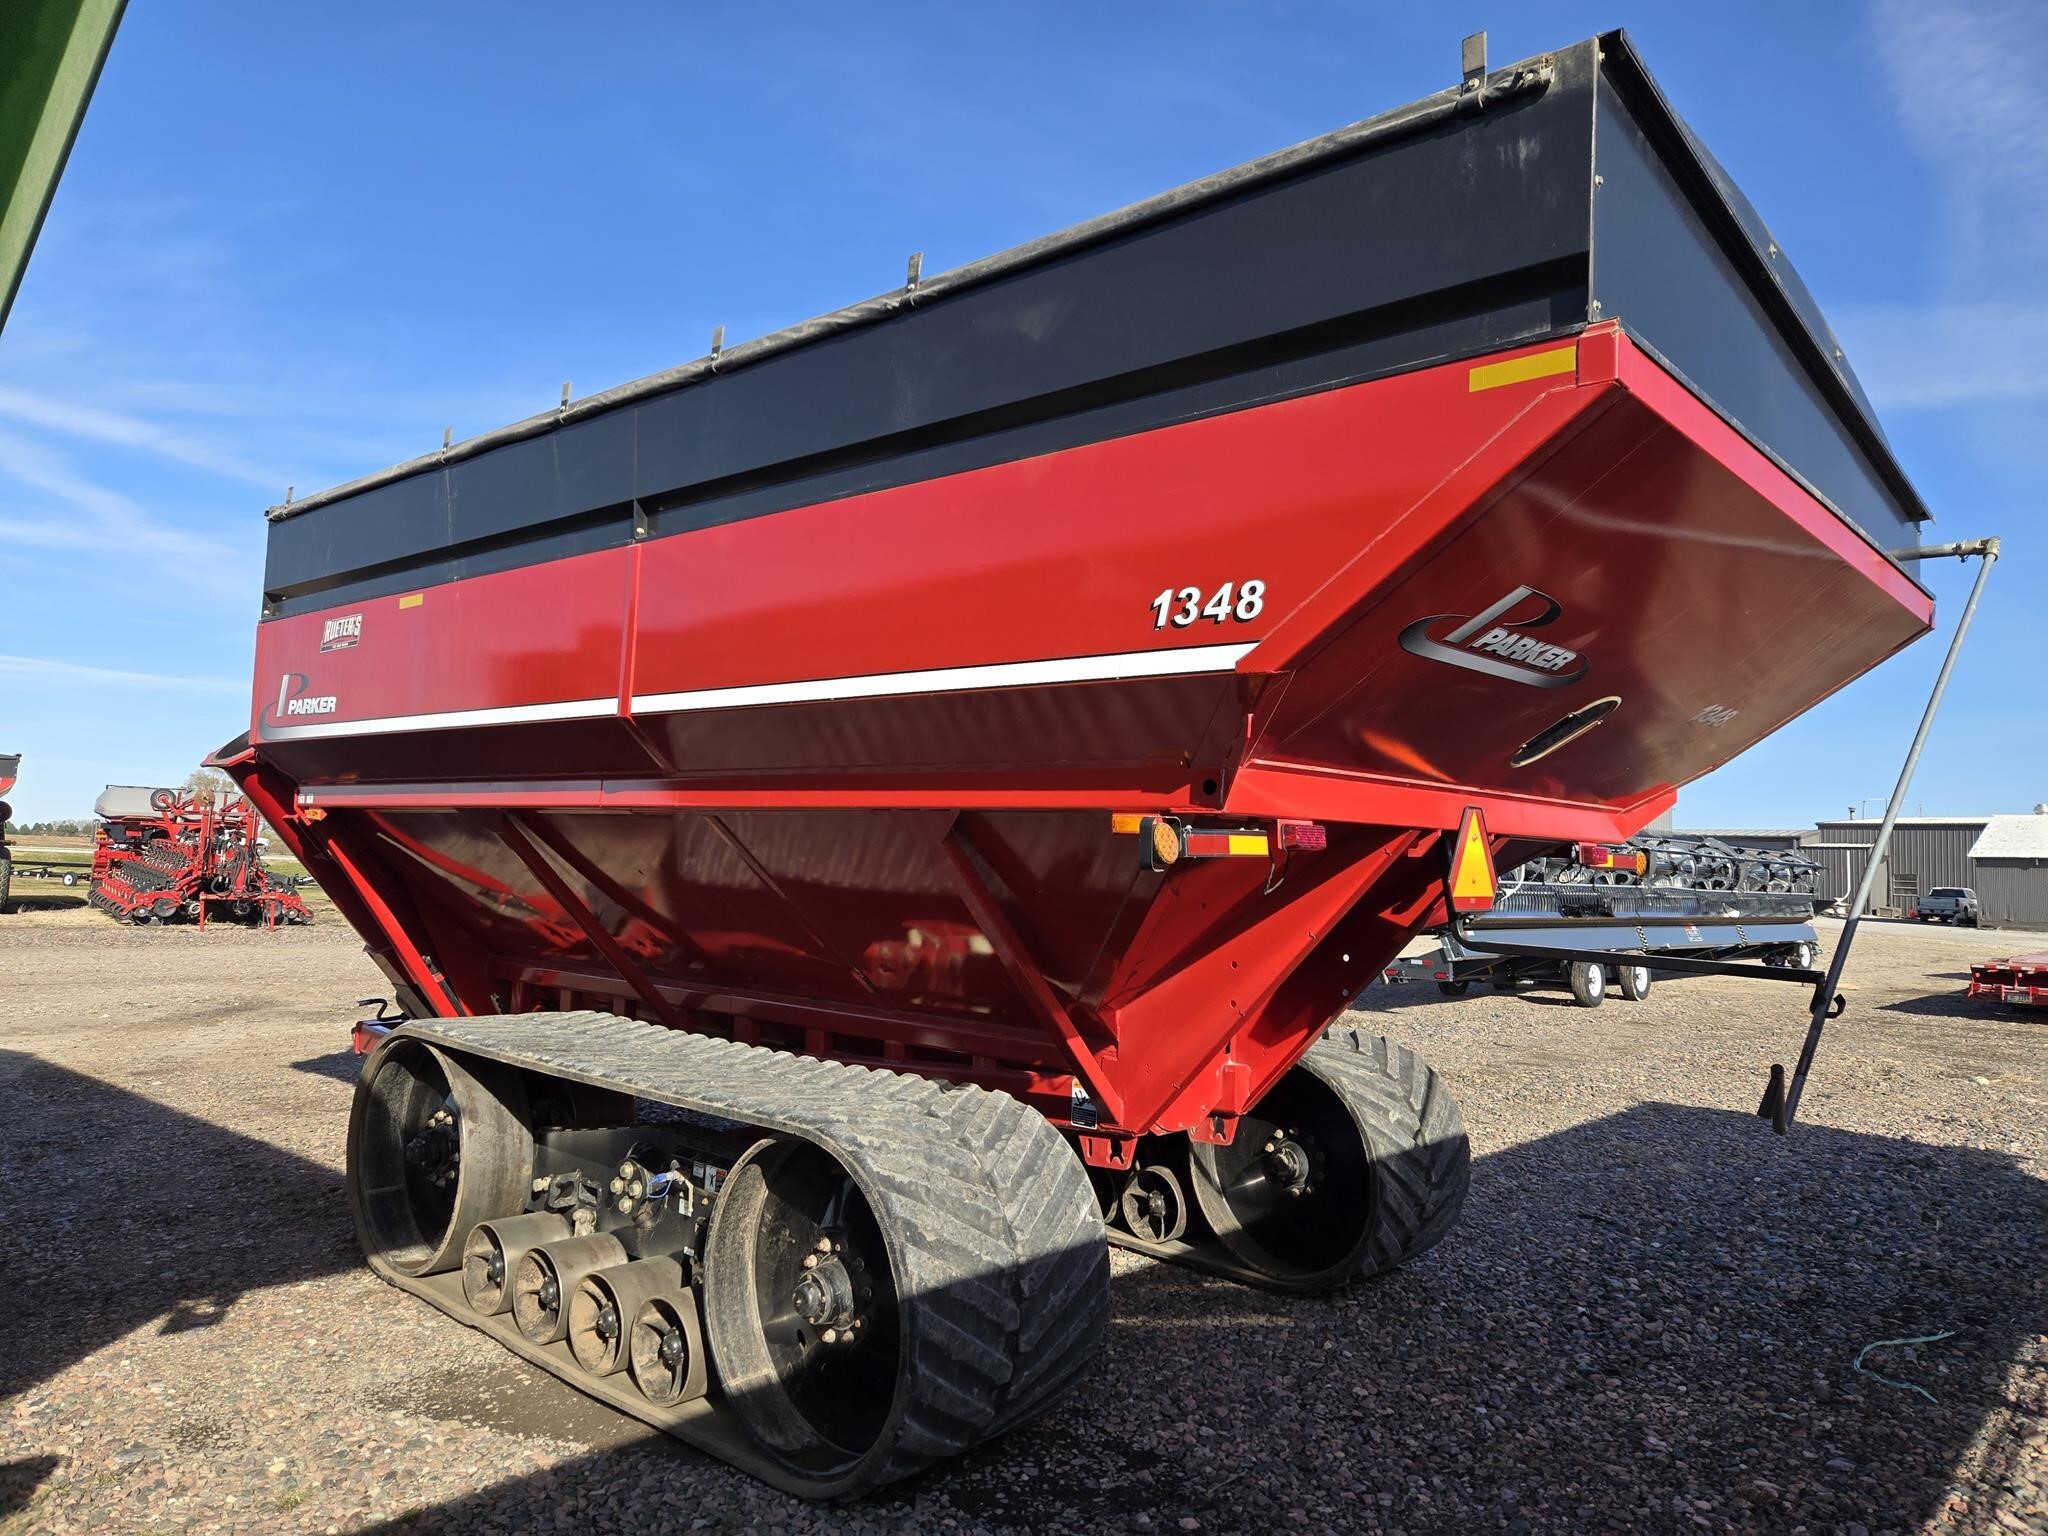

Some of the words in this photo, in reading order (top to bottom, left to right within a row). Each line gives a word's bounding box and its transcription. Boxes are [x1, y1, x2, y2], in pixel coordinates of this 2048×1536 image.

[1149, 579, 1266, 631] 1348
[1466, 627, 1577, 671] PARKER
[287, 696, 337, 715] PARKER
